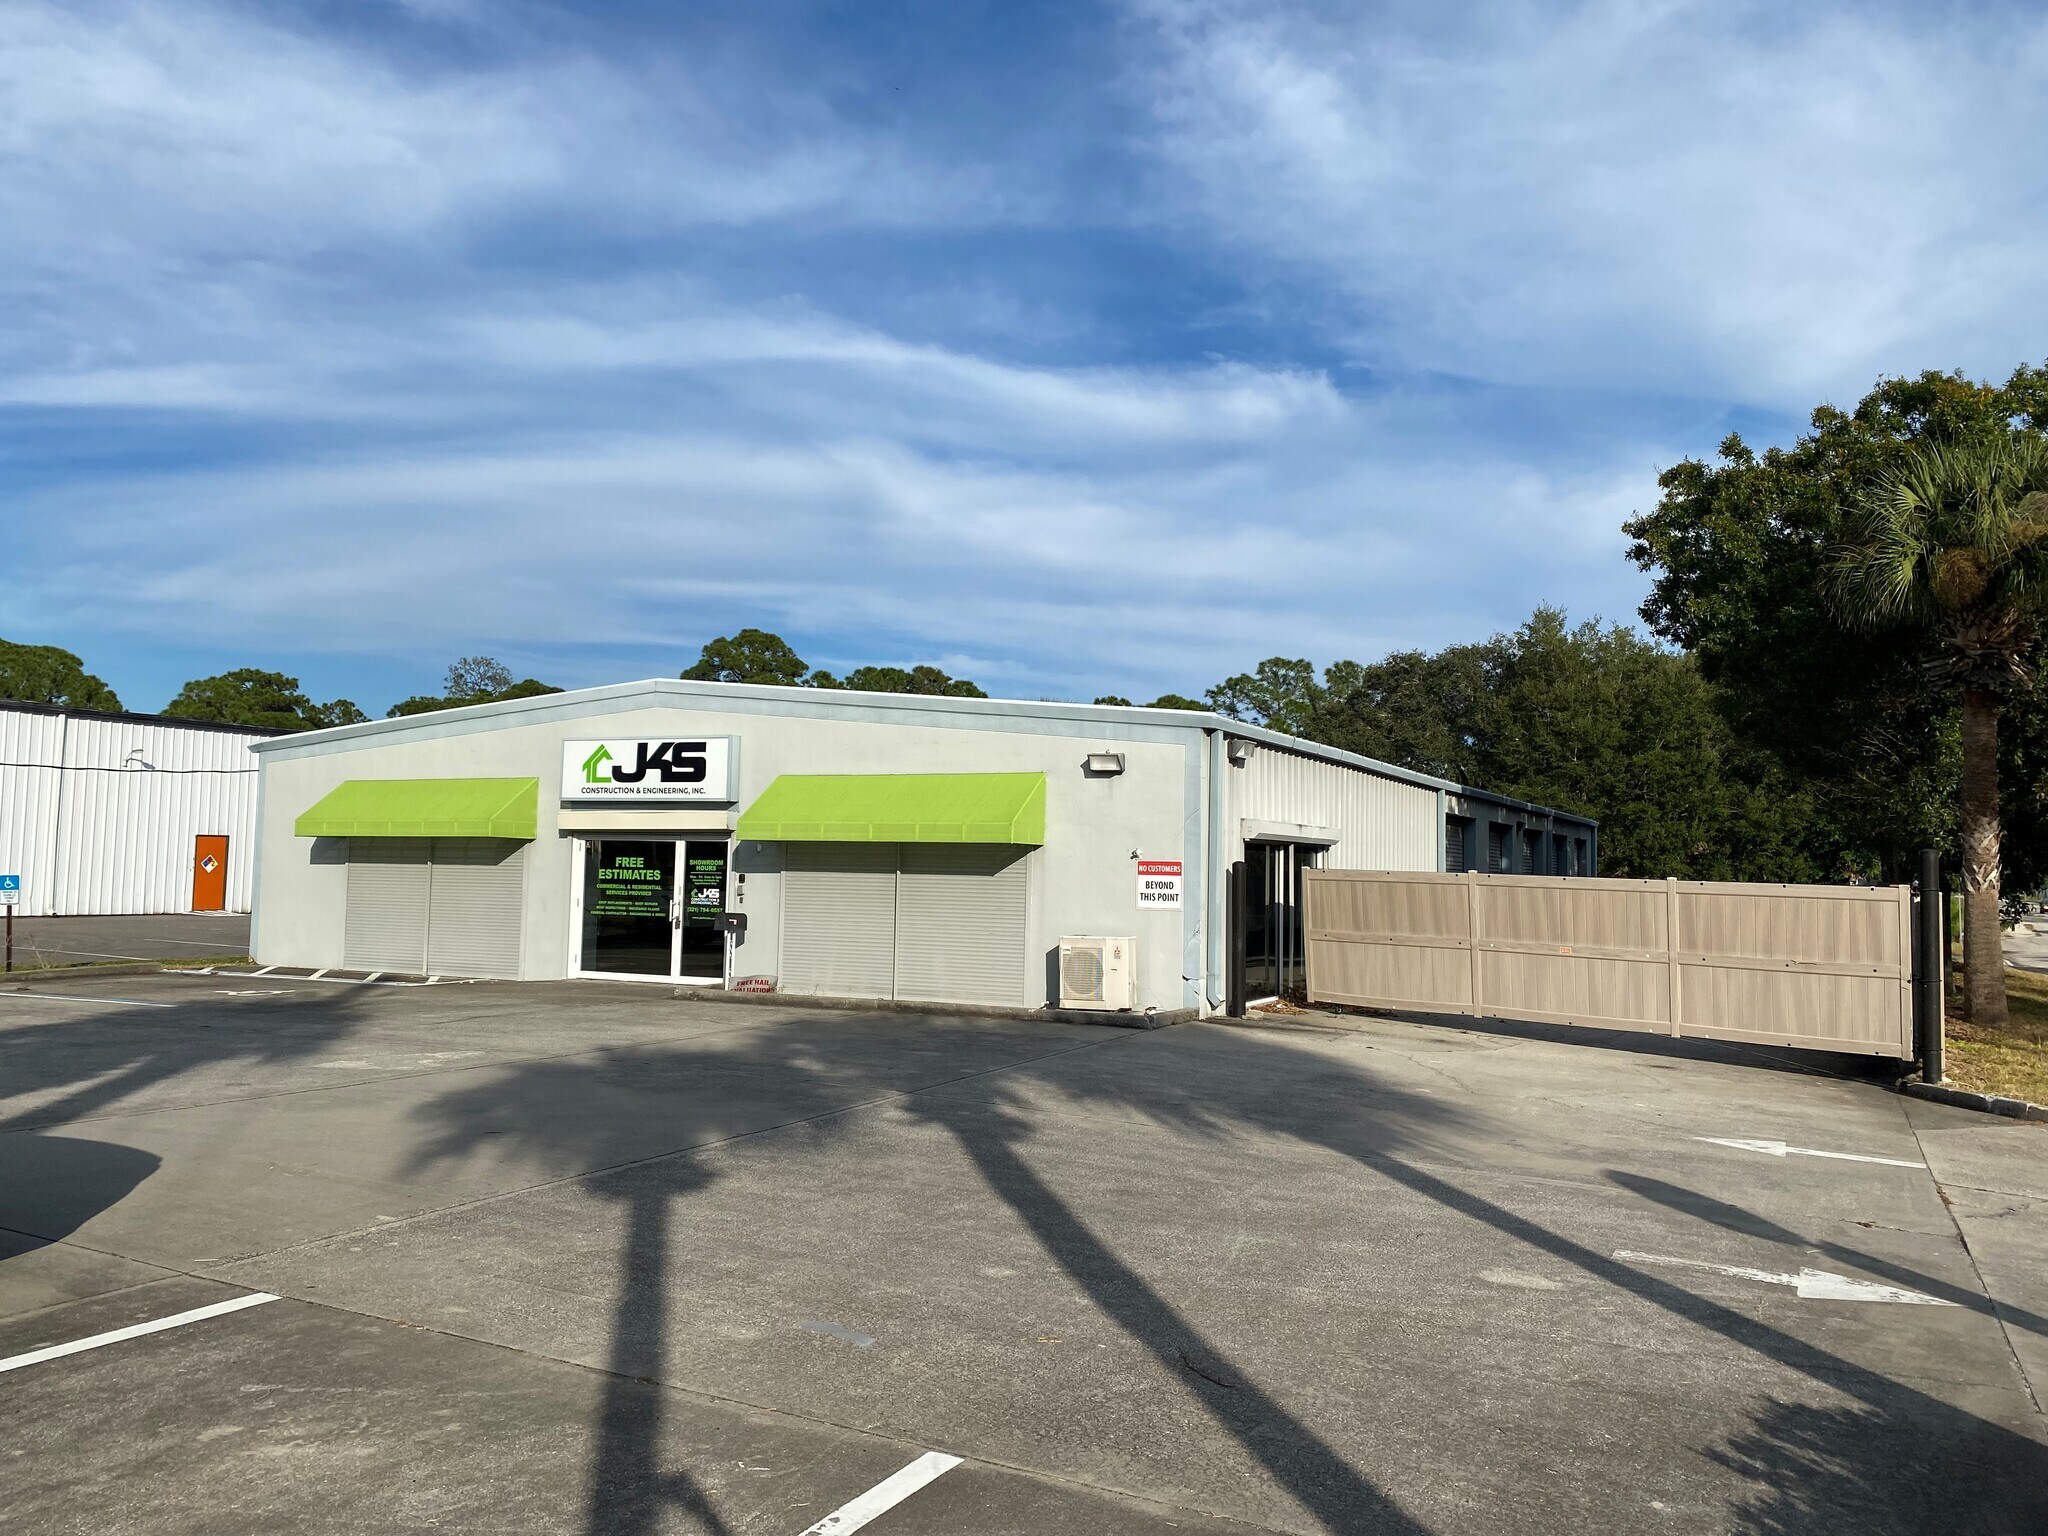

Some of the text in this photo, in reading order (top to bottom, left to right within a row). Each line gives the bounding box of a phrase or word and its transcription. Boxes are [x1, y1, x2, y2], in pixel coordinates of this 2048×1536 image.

[612, 742, 706, 783] JKS
[643, 787, 690, 795] ENGINEERING,
[615, 857, 644, 867] FREE
[599, 869, 661, 880] ESTIMATES
[1145, 881, 1174, 889] BEYOND
[698, 888, 719, 898] JKS
[1140, 893, 1179, 901] THIS POINT
